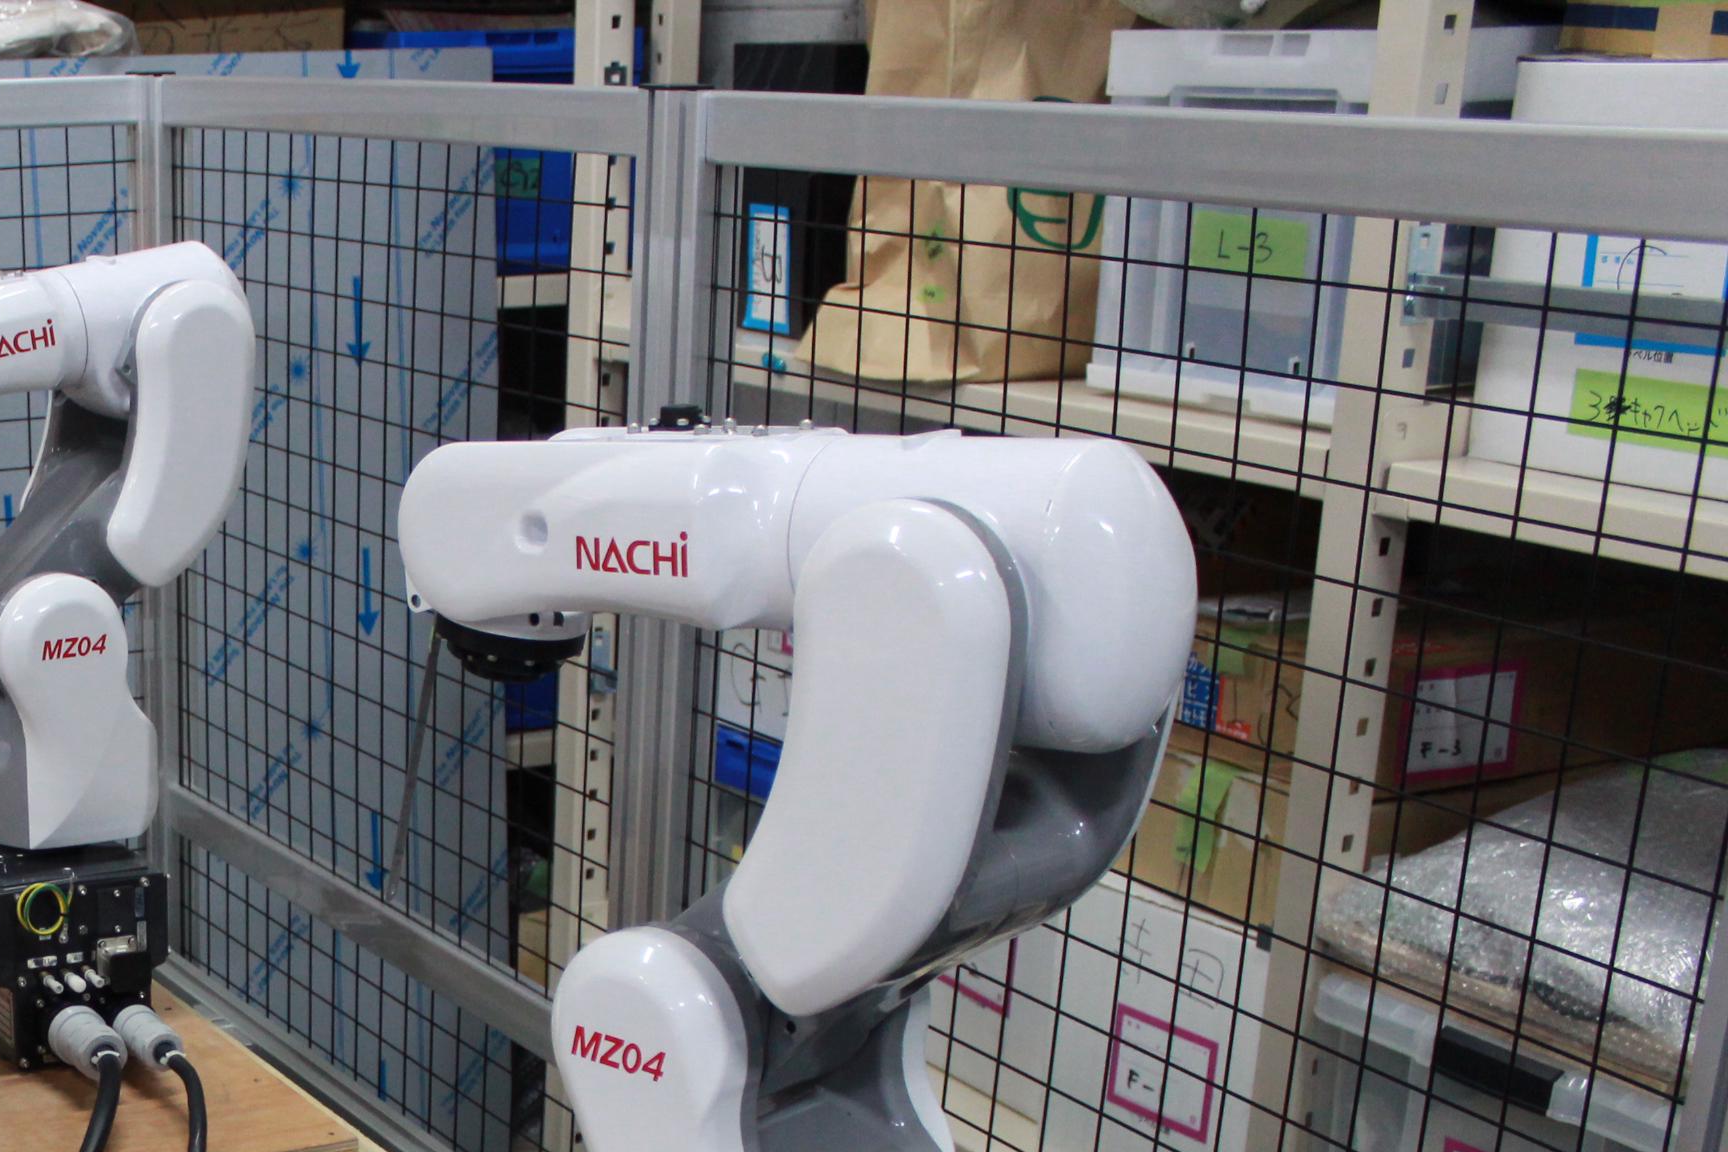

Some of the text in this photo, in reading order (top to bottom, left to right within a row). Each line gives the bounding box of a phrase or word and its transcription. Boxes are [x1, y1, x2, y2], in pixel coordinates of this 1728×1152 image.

[1216, 229, 1273, 263] L-3
[41, 633, 107, 661] MZ04
[570, 1024, 667, 1083] MZ04
